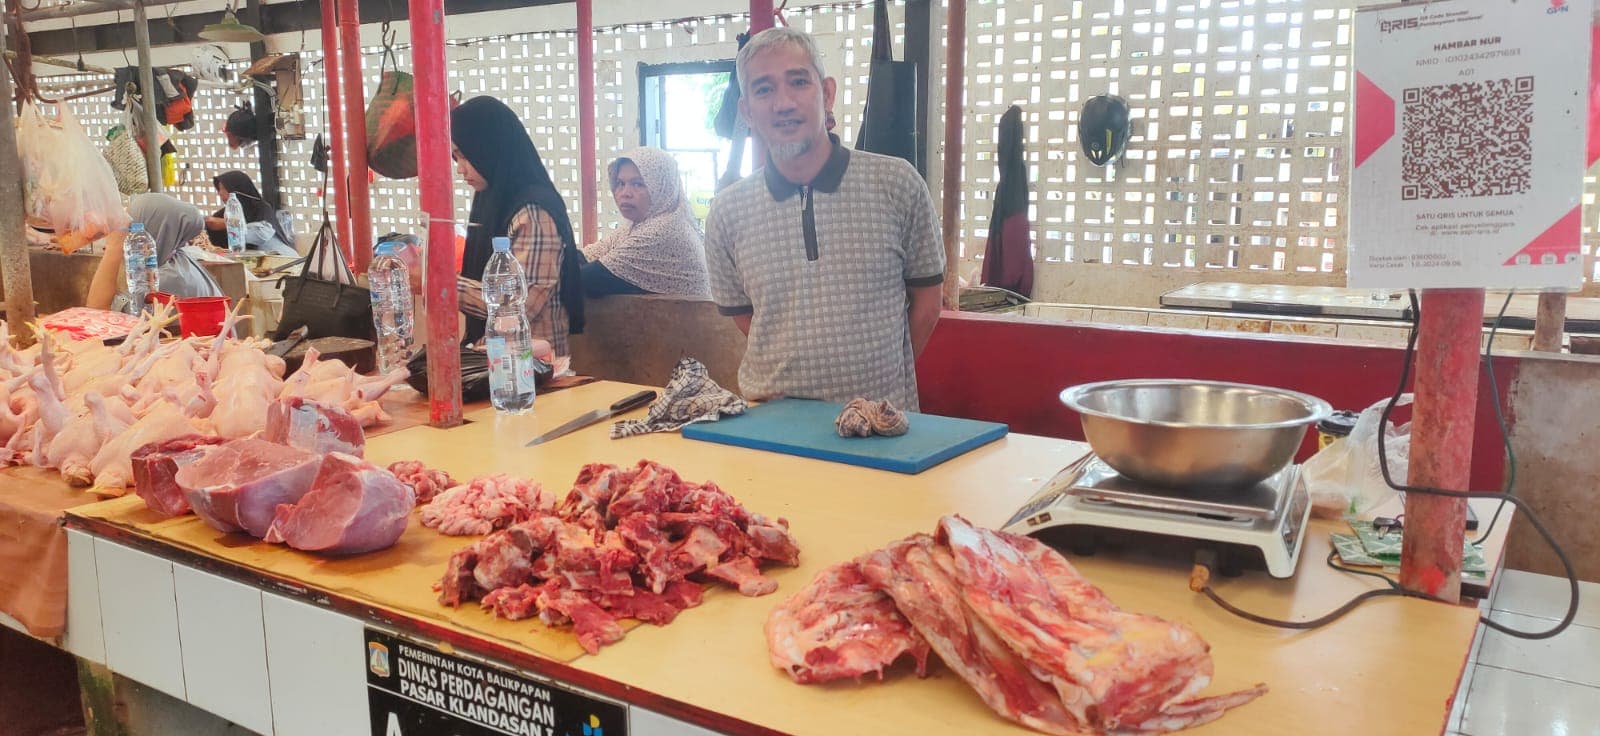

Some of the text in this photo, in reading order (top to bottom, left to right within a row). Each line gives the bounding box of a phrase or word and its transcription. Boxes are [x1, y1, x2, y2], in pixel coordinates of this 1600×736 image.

[1380, 17, 1418, 34] QRIS
[1434, 36, 1502, 52] HAMBAR NUR
[1416, 57, 1438, 67] NMID
[1458, 68, 1475, 76] A01
[1457, 210, 1484, 218] UNTUK
[1485, 209, 1514, 217] SEMUA
[398, 644, 551, 702] PEMERINTAH KOTA BALIKPAPAN
[398, 658, 555, 728] DINAS PERDAGANGAN
[400, 680, 446, 709] PASAR
[449, 695, 542, 736] KLANDASAN
